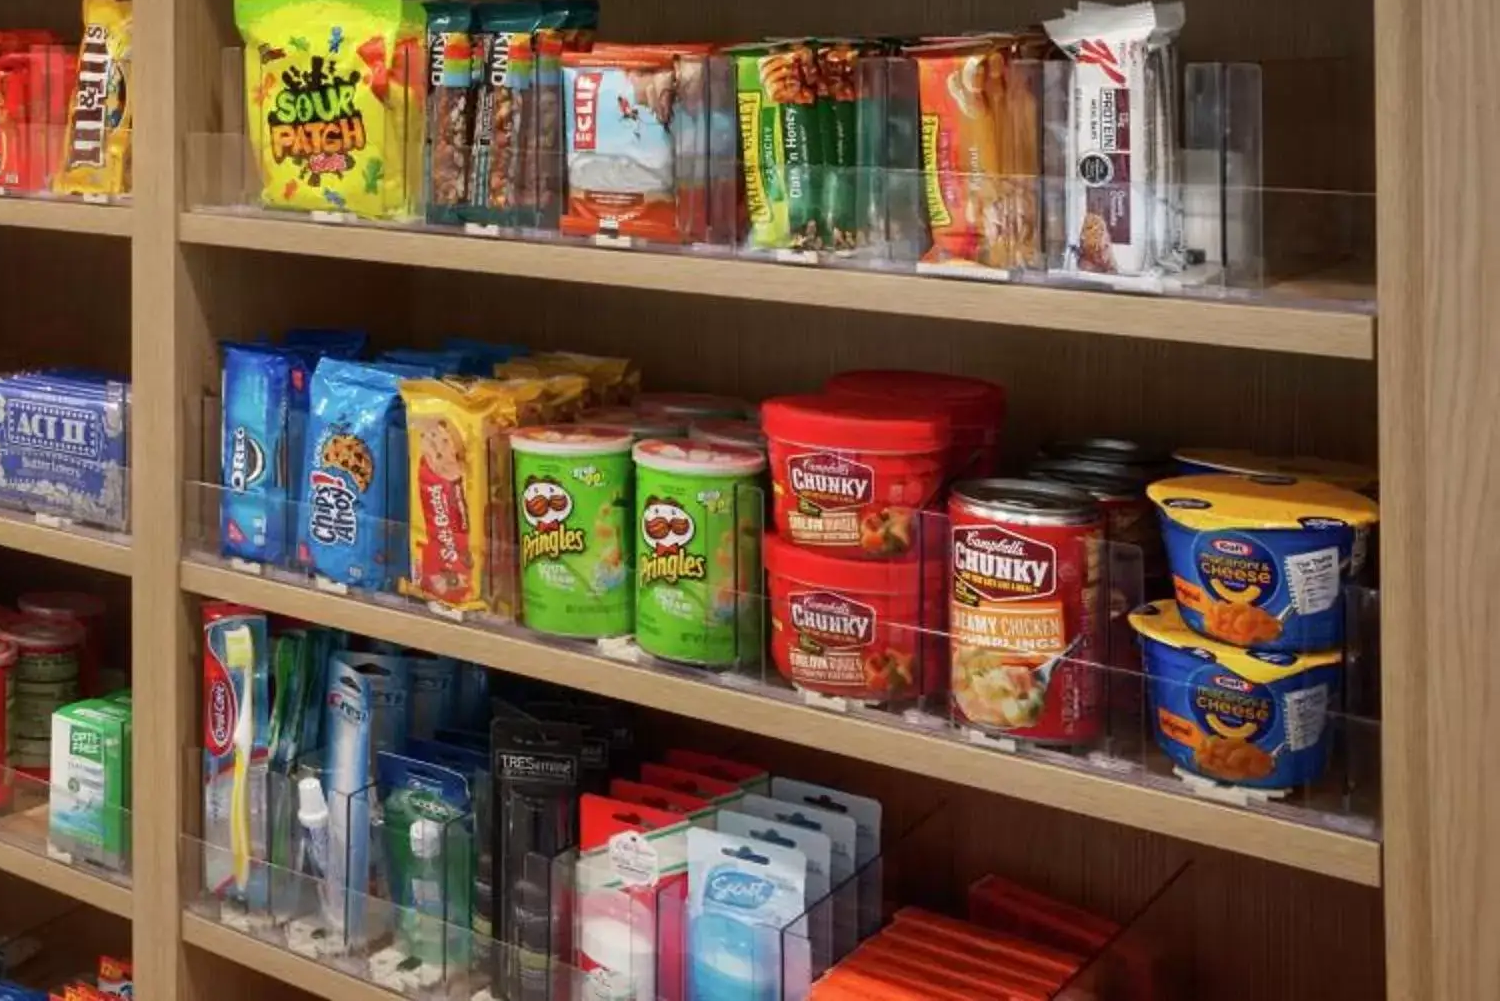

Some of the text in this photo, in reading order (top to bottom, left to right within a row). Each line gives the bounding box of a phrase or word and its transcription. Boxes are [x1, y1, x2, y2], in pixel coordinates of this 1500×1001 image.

[432, 33, 449, 85] KIND
[491, 33, 511, 85] KIND
[276, 86, 357, 123] SOUR
[577, 73, 600, 130] CLIF
[1102, 90, 1115, 149] PROTEIN
[271, 119, 366, 163] PATCH
[785, 106, 800, 150] Honey
[17, 411, 87, 446] ACT II
[230, 426, 246, 493] OREO
[791, 467, 869, 500] CHUNKY
[522, 526, 585, 567] Pringles
[954, 541, 1049, 587] CHUNKY
[639, 555, 706, 587] Pringles
[791, 603, 869, 639] CHUNKY
